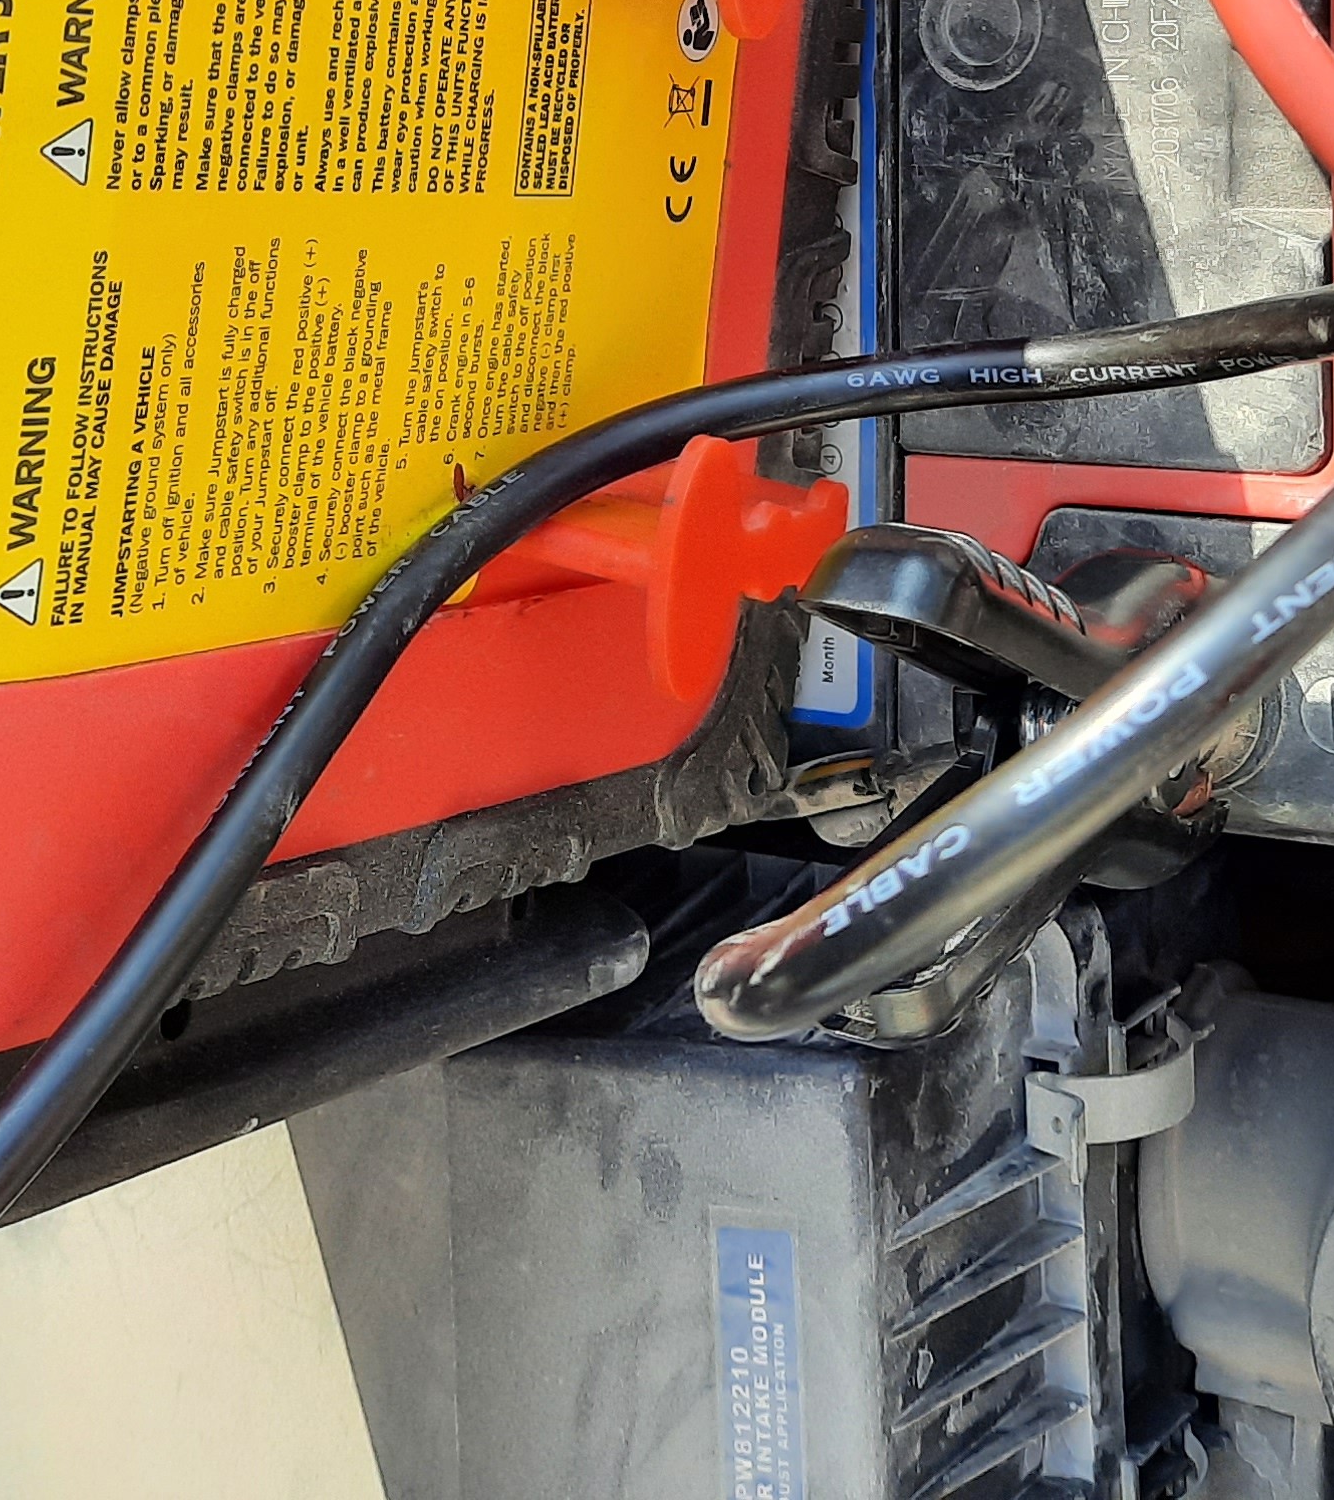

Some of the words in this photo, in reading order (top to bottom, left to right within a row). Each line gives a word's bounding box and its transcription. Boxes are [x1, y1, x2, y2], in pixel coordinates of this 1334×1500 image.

[211, 2, 226, 35] the
[474, 12, 486, 30] IS
[559, 22, 571, 45] OR
[138, 29, 157, 117] common
[206, 40, 223, 81] that
[225, 30, 244, 101] clamps
[542, 53, 555, 89] ACID
[567, 8, 585, 88] PROPERLY.
[1101, 59, 1130, 81] IN
[113, 70, 131, 124] allow
[162, 70, 173, 92] or
[434, 35, 453, 118] OPERATE
[465, 35, 484, 131] CHARGING
[551, 47, 568, 123] RECYCLED
[565, 91, 576, 112] OF
[136, 123, 148, 136] a
[176, 78, 193, 141] result.
[203, 86, 218, 130] sure
[526, 101, 537, 113] A
[538, 92, 551, 129] LEAD
[105, 129, 125, 190] Never
[130, 142, 146, 163] to
[217, 106, 235, 191] negative
[429, 122, 443, 160] NOT
[445, 122, 460, 164] THIS
[474, 88, 495, 193] PROGRESS.
[518, 116, 536, 190] CONTAINS
[532, 133, 547, 190] SEALED
[549, 126, 561, 146] BE
[557, 115, 574, 190] DISPOSED
[1101, 97, 1132, 182] MADE
[130, 168, 142, 191] or
[171, 147, 188, 190] may
[194, 136, 212, 191] Make
[426, 165, 439, 193] DO
[442, 168, 454, 193] OF
[458, 135, 475, 194] WHILE
[544, 148, 558, 190] MUST
[226, 245, 246, 319] charged
[76, 249, 108, 406] INSTRUCTIONS
[98, 280, 122, 371] DAMAGE
[183, 260, 205, 369] accessories
[220, 323, 239, 360] fully
[159, 333, 177, 378] only)
[217, 365, 232, 381] is
[846, 367, 942, 390] 6AWG
[968, 364, 1044, 386] HIGH
[1069, 362, 1199, 384] CURRENT
[132, 345, 155, 434] VEHICLE
[179, 375, 192, 396] all
[90, 377, 112, 449] CAUSE
[151, 383, 169, 449] system
[174, 403, 189, 437] and
[206, 386, 230, 477] Jumpstart
[5, 356, 56, 551] WARNING
[65, 412, 89, 500] FOLLOW
[130, 439, 144, 454] A
[83, 454, 102, 499] MAY
[142, 455, 160, 520] ground
[163, 443, 184, 510] ignition
[203, 482, 218, 523] sure
[61, 506, 78, 535] TO
[110, 459, 142, 618] JUMPSTARTING
[161, 516, 175, 541] off
[176, 492, 195, 562] vehicle.
[71, 505, 96, 595] MANUAL
[128, 526, 152, 614] (Negative
[172, 566, 186, 585] of
[193, 528, 212, 579] Make
[320, 556, 414, 659] POWER
[429, 468, 527, 539] CABLE
[49, 539, 75, 627] FAILURE
[151, 592, 166, 610] 1.
[190, 586, 205, 605] 2.
[68, 601, 84, 624] IN
[822, 635, 836, 684] Month
[1013, 660, 1211, 806] POWER
[823, 823, 971, 938] CABLE
[747, 1252, 769, 1366] MODULE
[772, 1322, 788, 1451] APPLICATION
[753, 1374, 773, 1474] INTAKE
